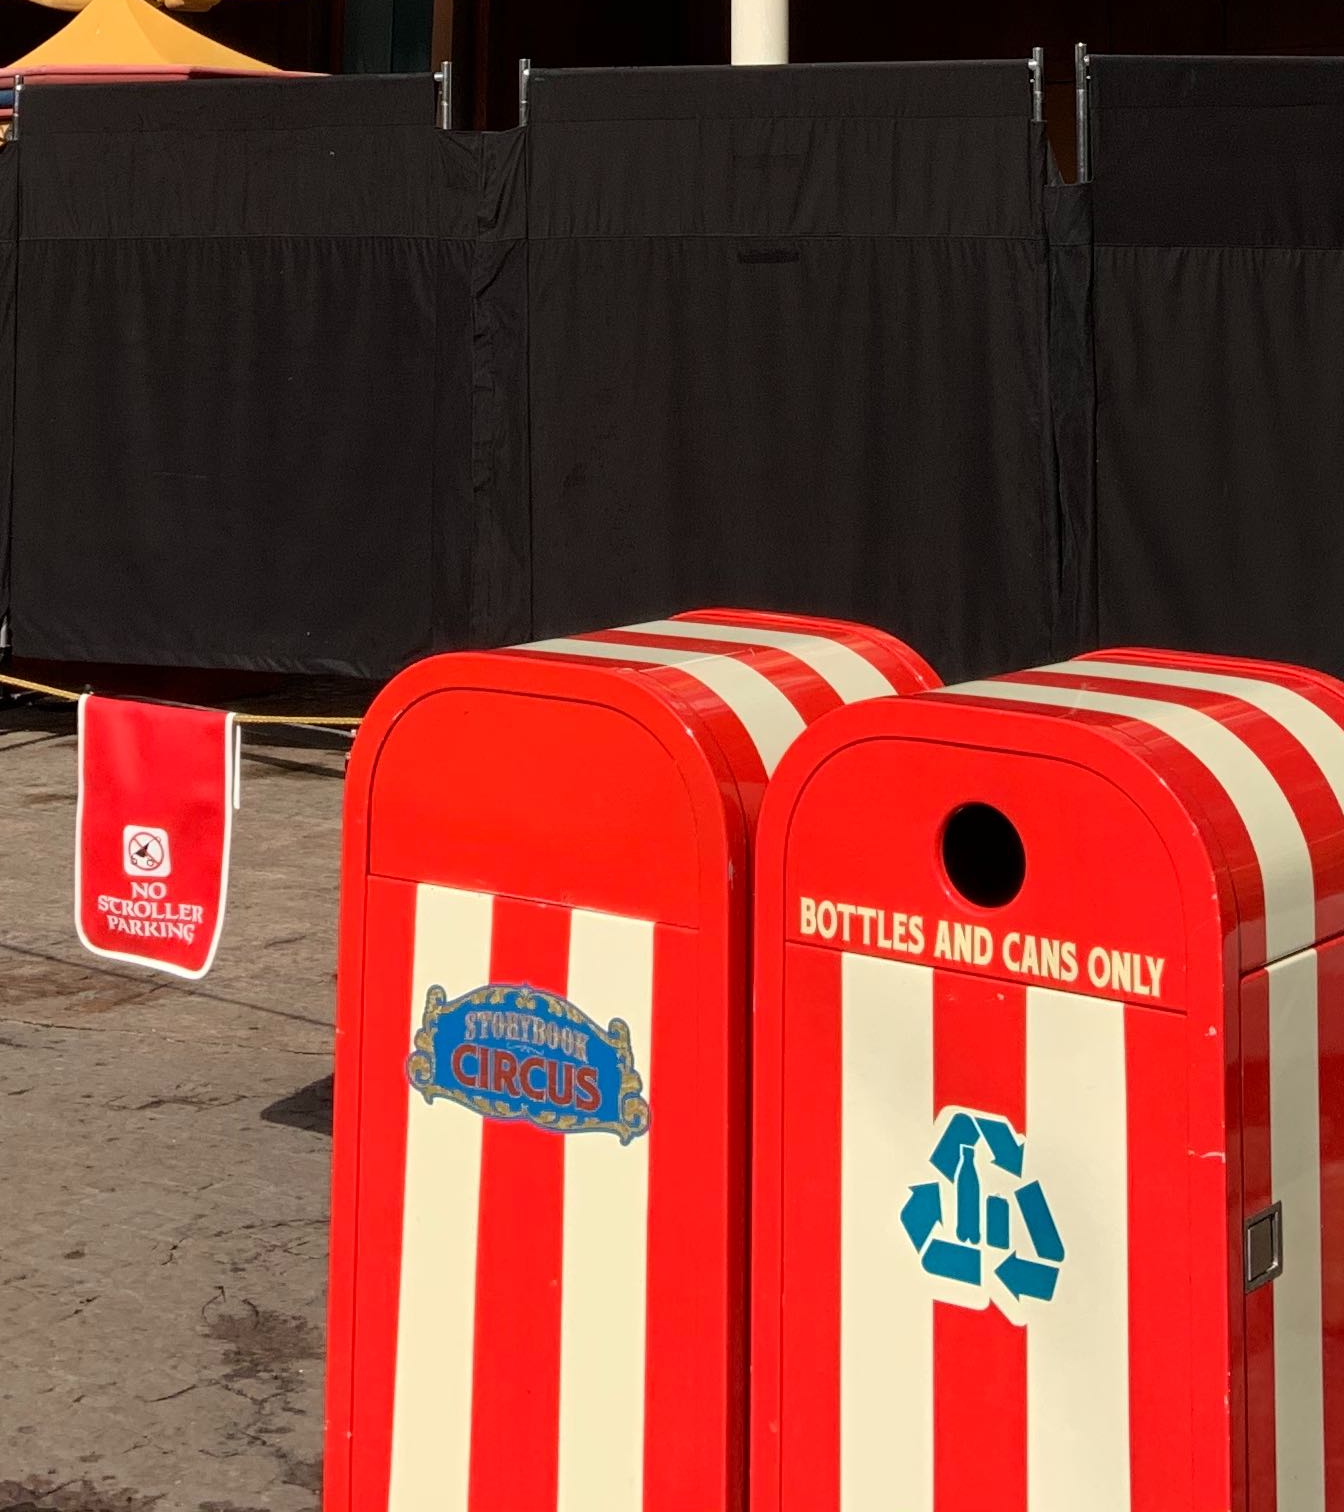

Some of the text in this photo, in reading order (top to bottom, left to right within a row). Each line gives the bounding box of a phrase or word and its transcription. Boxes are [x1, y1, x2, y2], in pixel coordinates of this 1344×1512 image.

[98, 894, 203, 925] STROLLER
[131, 881, 167, 900] NO
[106, 914, 195, 945] PARKING
[799, 896, 1165, 997] BOTTLES AND CANS ONLY
[464, 1010, 590, 1062] STORYBOOK
[451, 1043, 602, 1113] CIRCUS
